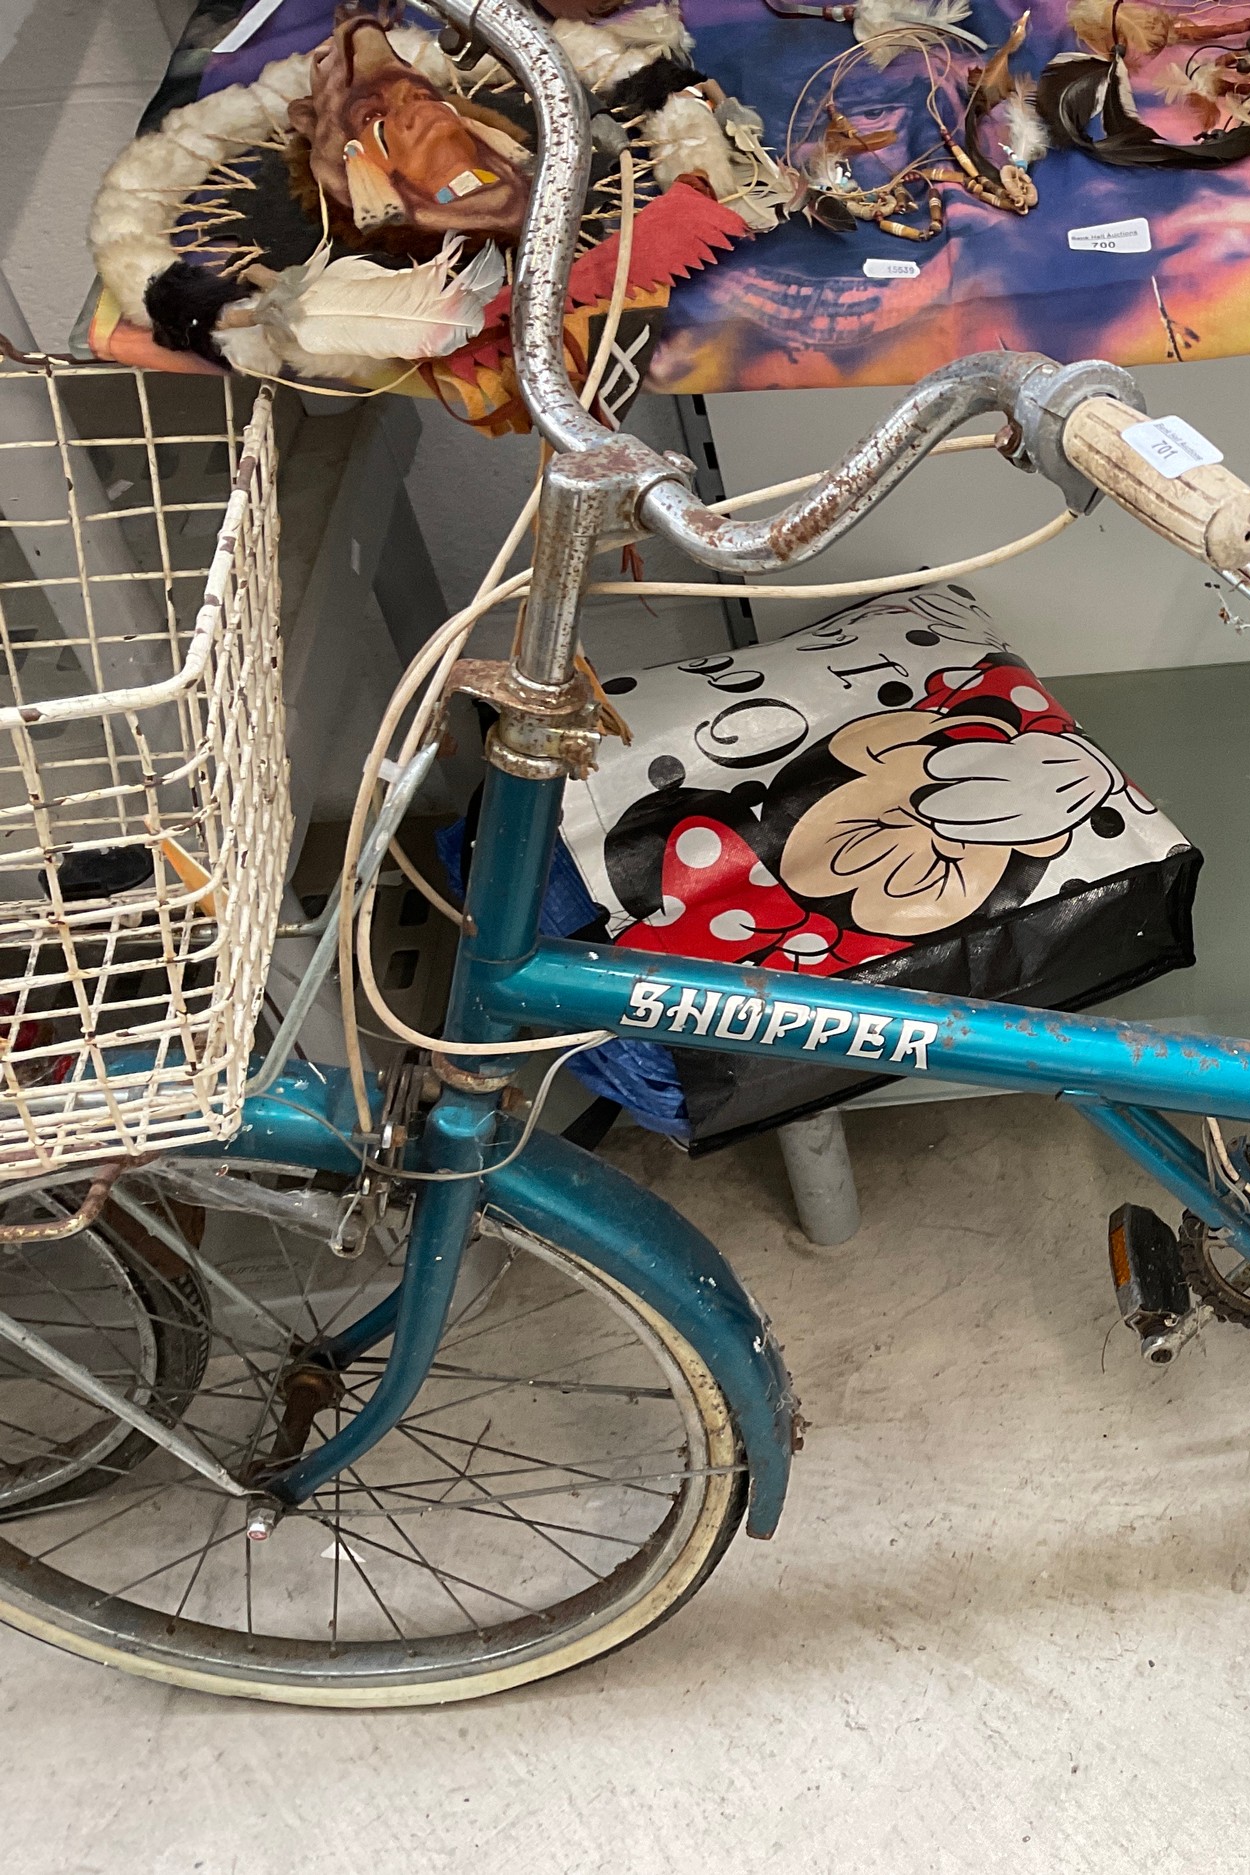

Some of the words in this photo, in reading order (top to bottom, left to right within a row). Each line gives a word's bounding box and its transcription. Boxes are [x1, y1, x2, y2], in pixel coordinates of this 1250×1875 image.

[1107, 229, 1139, 240] Auctions
[1091, 241, 1117, 249] 700
[1151, 440, 1178, 460] 701
[619, 981, 940, 1071] SHOPPER
